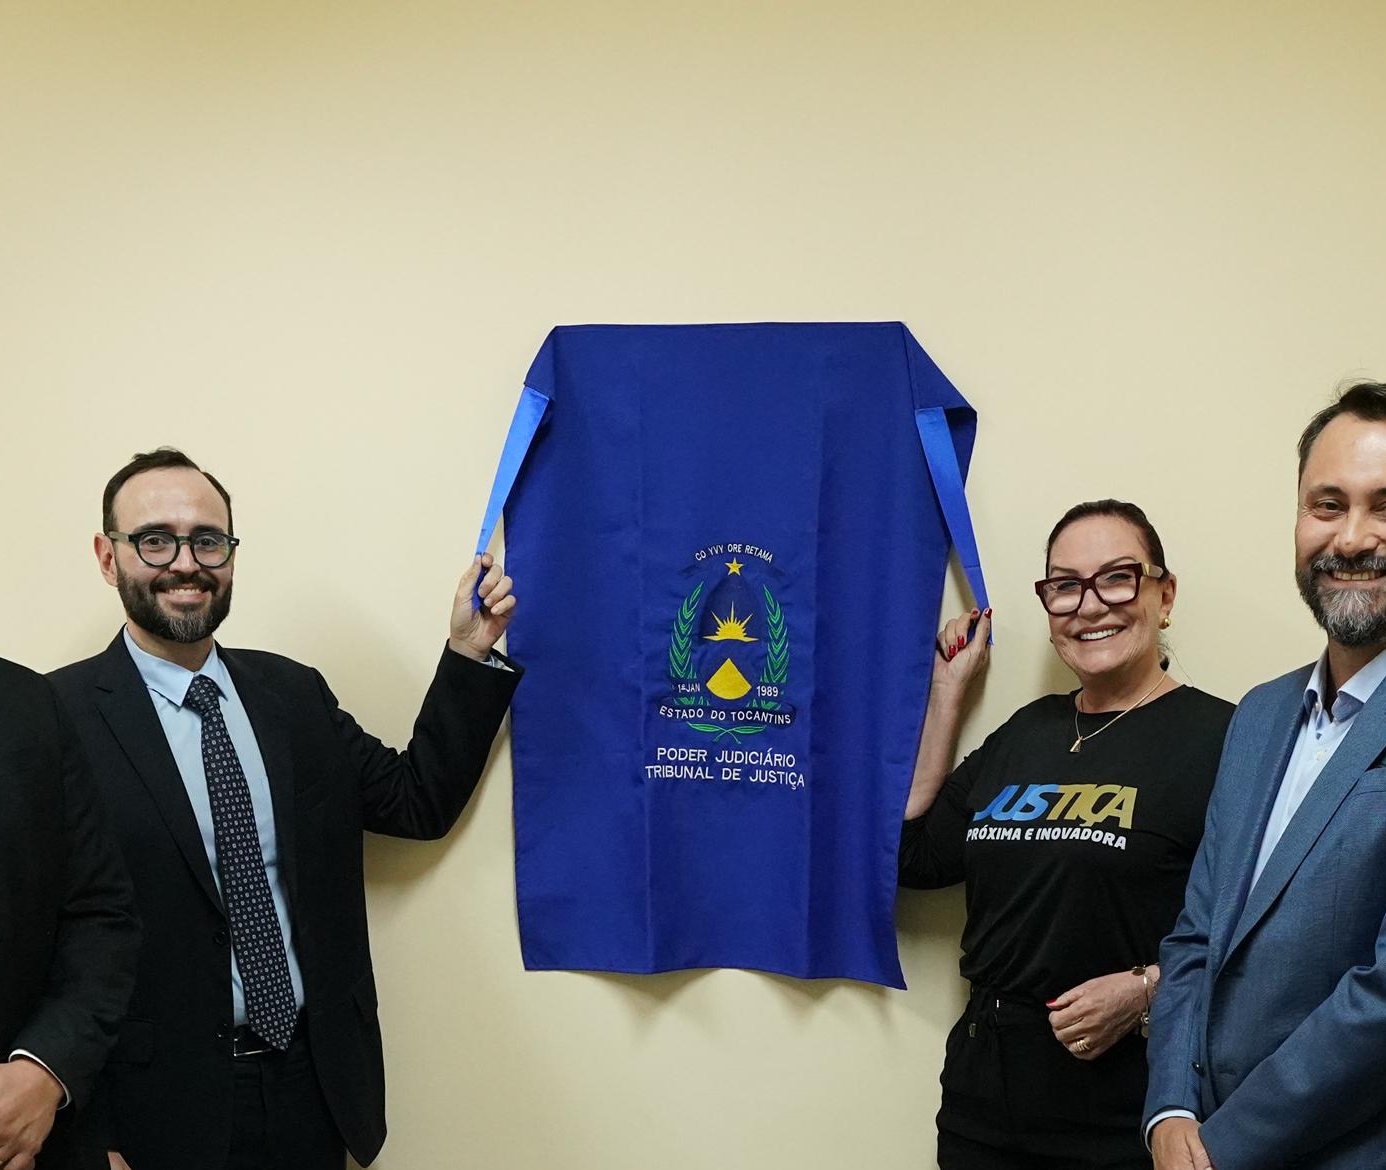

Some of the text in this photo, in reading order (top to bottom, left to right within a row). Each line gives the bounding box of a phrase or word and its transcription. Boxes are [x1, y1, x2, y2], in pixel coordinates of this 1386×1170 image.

[695, 543, 774, 564] CO YVY ORE RETAMA
[756, 685, 779, 697] 1989
[659, 704, 791, 725] ESTADO DO TOCANTINS
[656, 747, 796, 768] PODER JUDICIÁRIO
[645, 765, 805, 790] TRIBUNAL DE JUSTIÇA
[972, 783, 1138, 830] JUSTIÇA
[966, 825, 1127, 851] PRÓXIMA E INOVADORA
